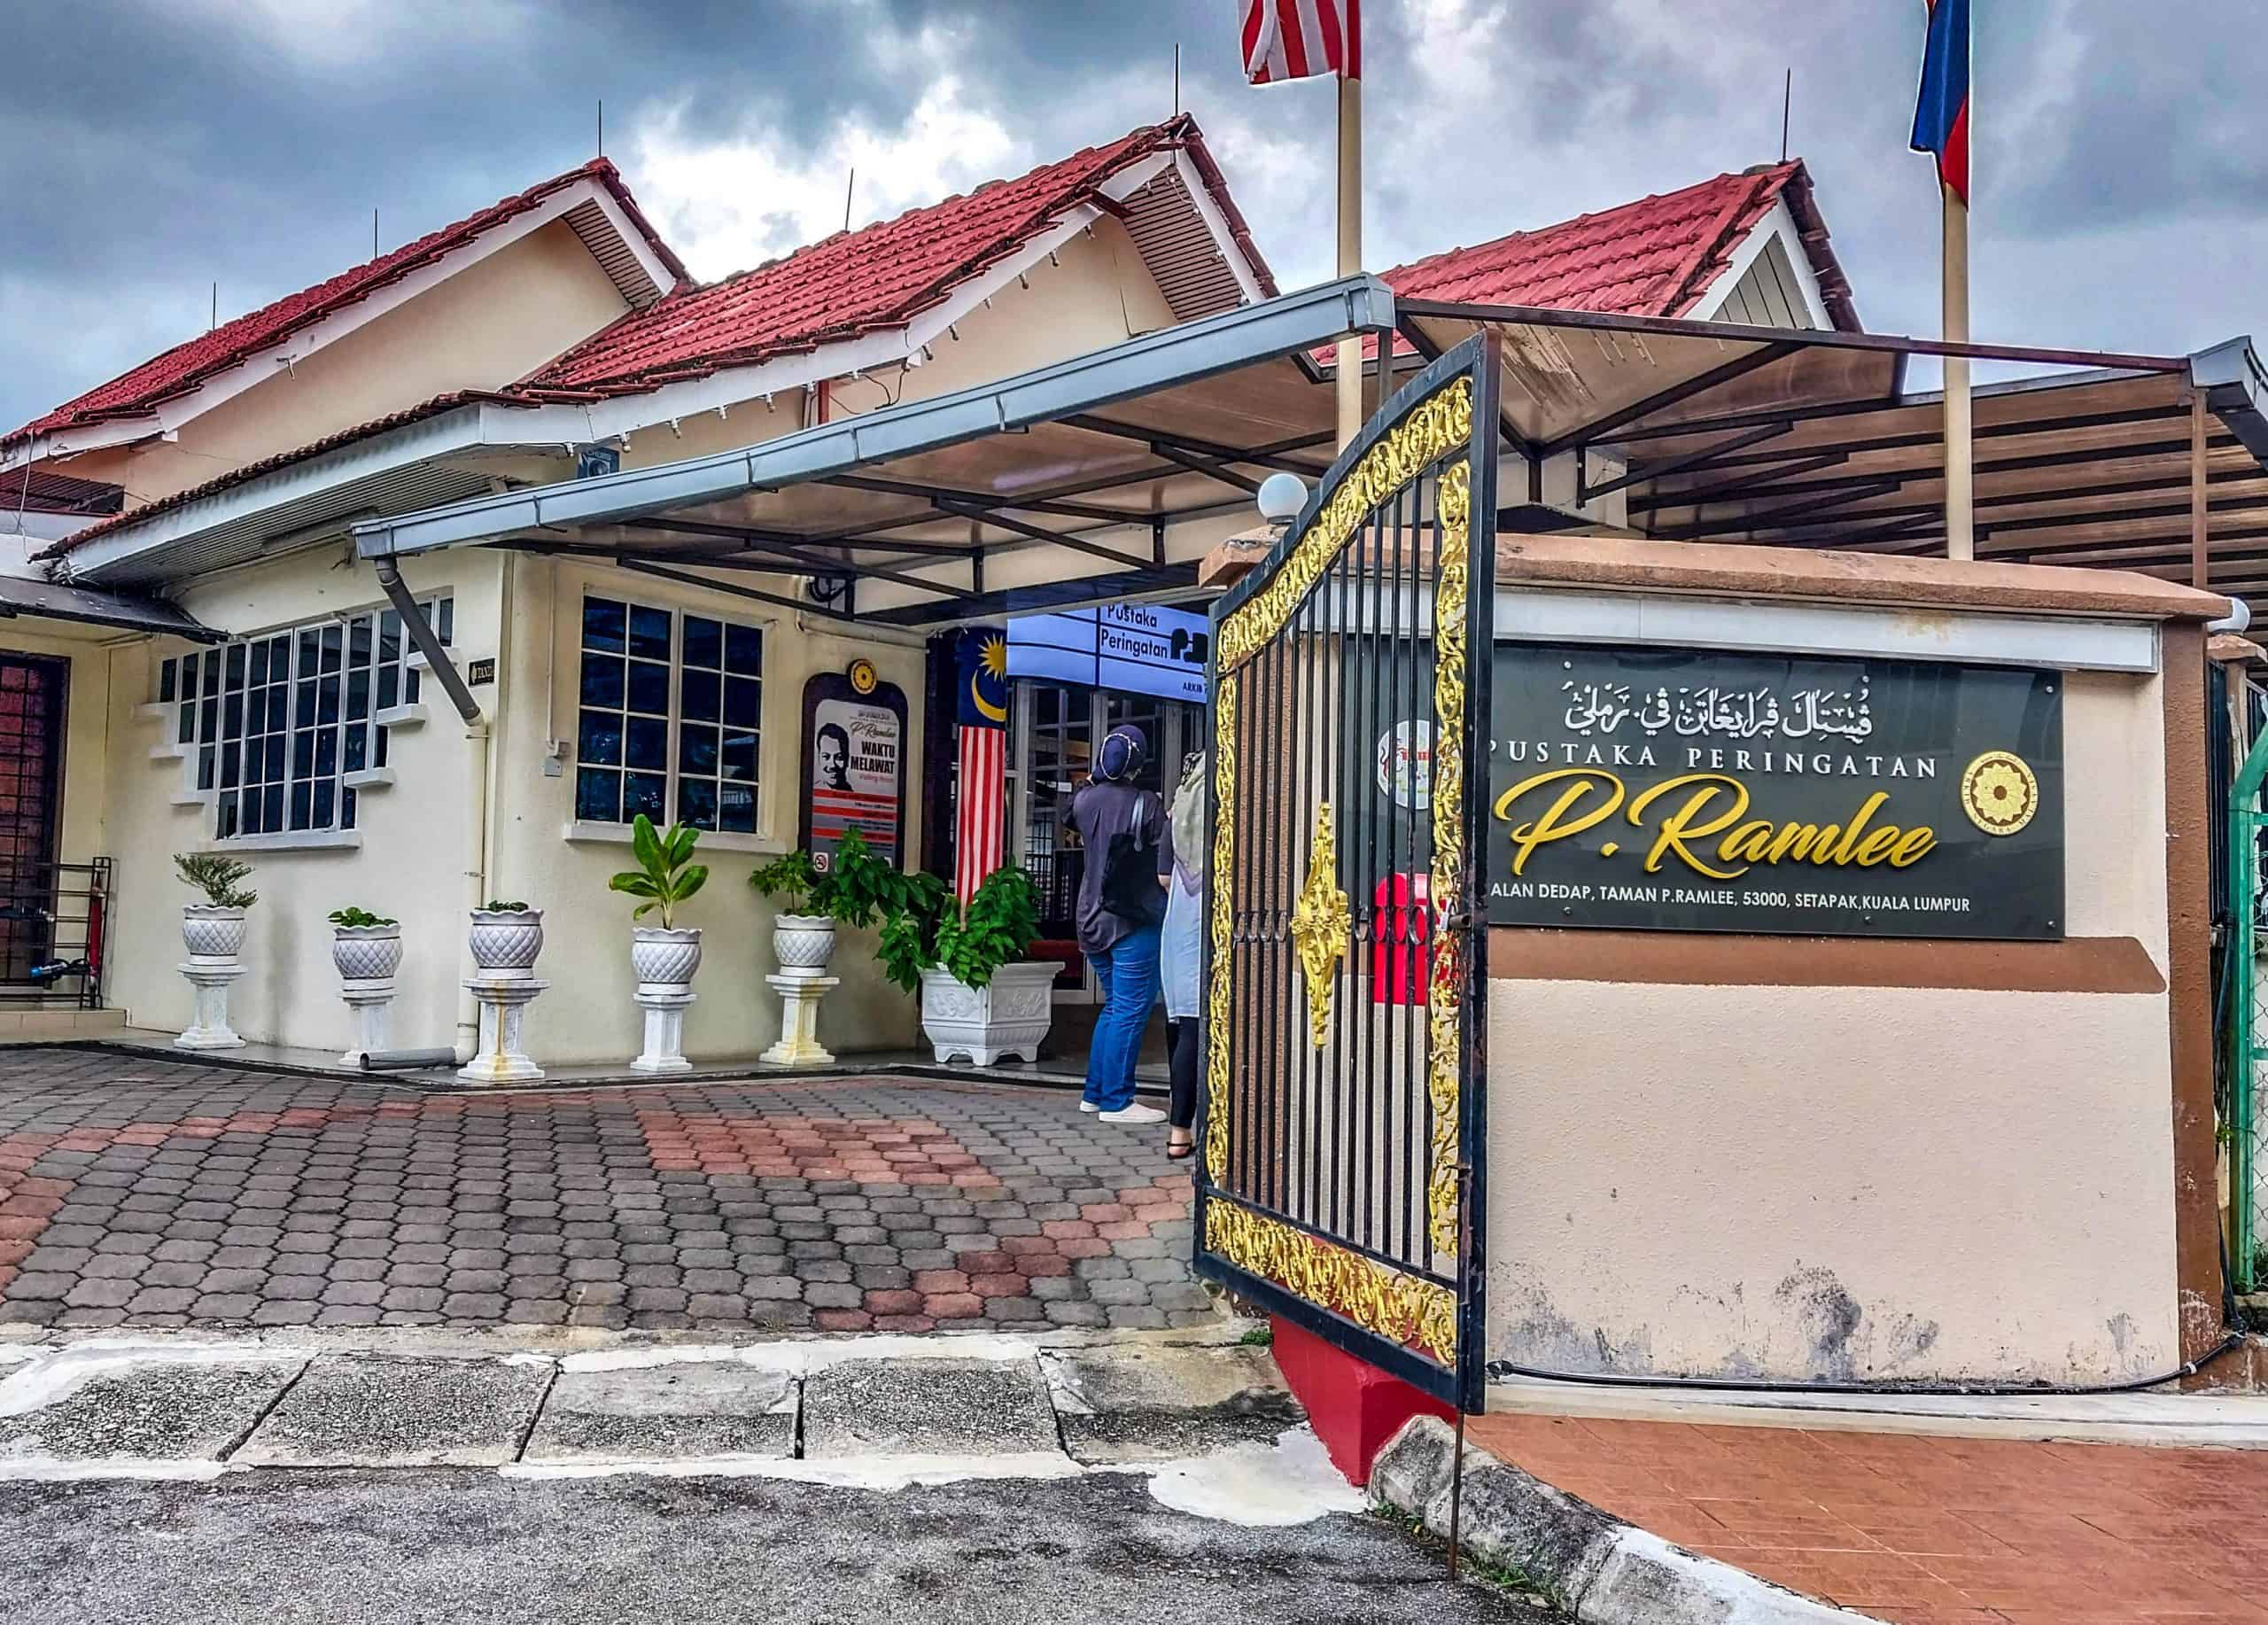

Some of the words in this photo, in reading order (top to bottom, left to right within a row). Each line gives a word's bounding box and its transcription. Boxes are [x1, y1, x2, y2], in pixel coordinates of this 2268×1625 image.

[1107, 603, 1157, 628] Pustaka
[1101, 628, 1169, 659] Peringatan
[861, 741, 895, 759] WAKTU
[1686, 747, 1936, 778] PERINGATAN
[850, 756, 895, 774] MELAWAT
[1489, 882, 1534, 898] ALAN
[1538, 883, 1596, 901] DEDAP,
[1599, 885, 1657, 903] TAMAN
[1743, 891, 1790, 908] 53000,
[1914, 896, 1971, 913] LUMPUR
